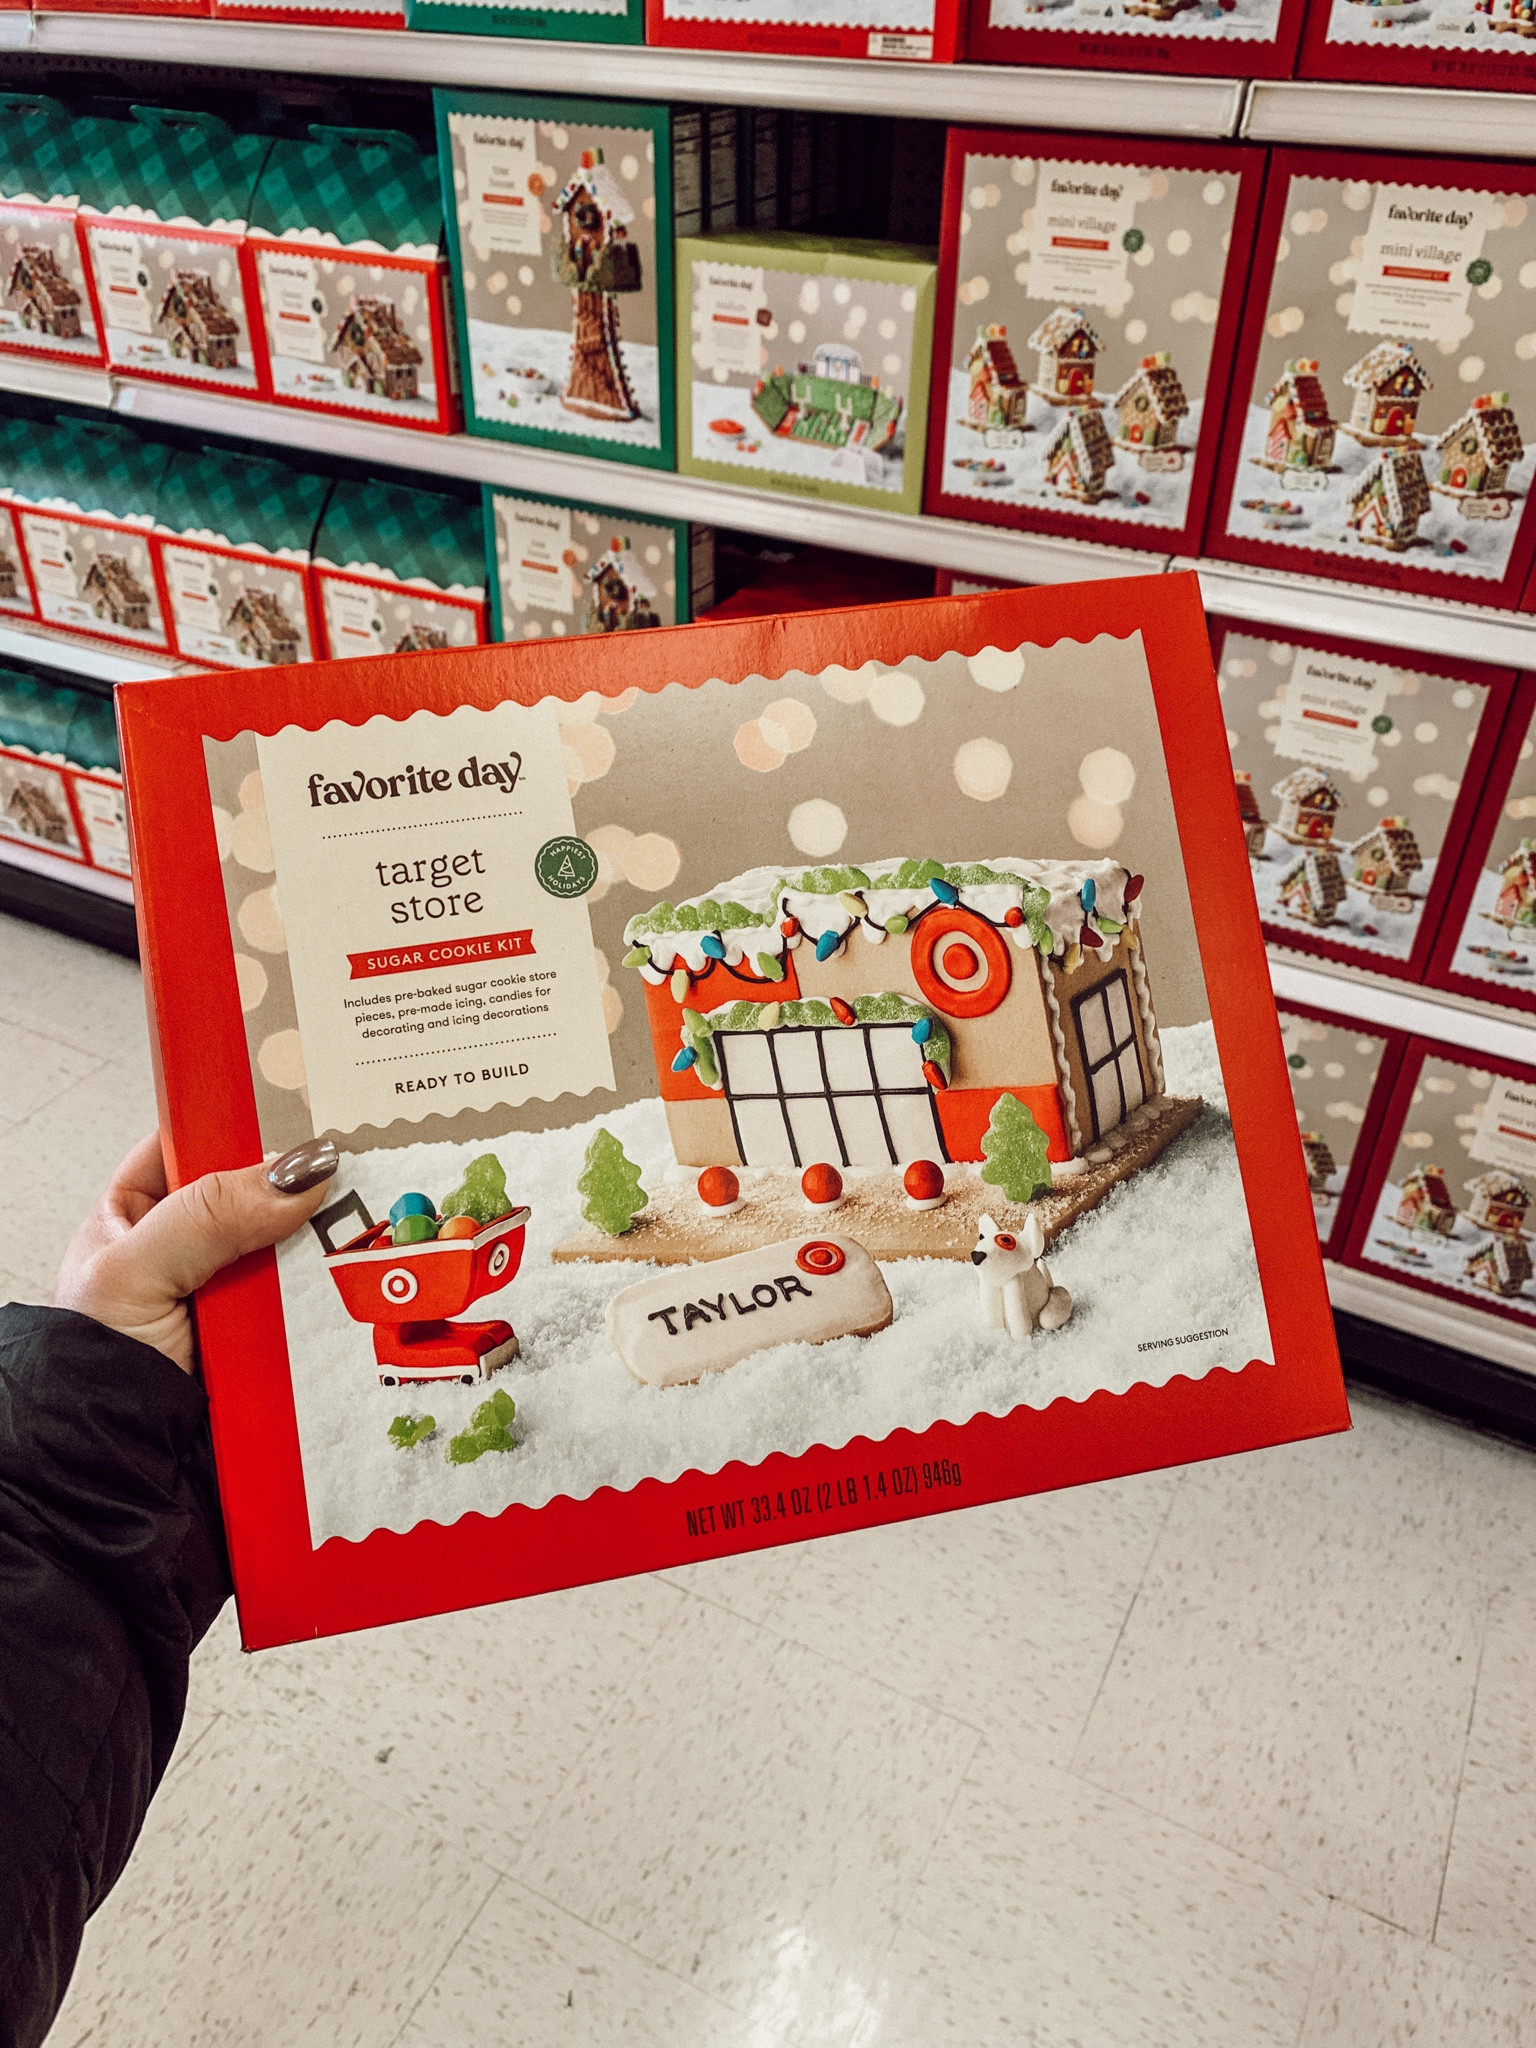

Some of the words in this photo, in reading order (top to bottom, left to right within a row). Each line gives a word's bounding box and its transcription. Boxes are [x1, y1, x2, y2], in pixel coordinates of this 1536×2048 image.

[1388, 204, 1443, 225] favorite
[1445, 211, 1473, 230] day
[1380, 242, 1413, 258] mini
[1415, 245, 1462, 265] village
[307, 764, 453, 808] favorite
[375, 849, 486, 888] target
[550, 845, 586, 860] HAPPIEST
[547, 874, 586, 890] HOLIDAYS
[390, 890, 485, 925] store
[367, 952, 424, 971] SUGAR
[429, 942, 493, 962] COOKIE
[497, 937, 523, 953] KIT
[343, 993, 392, 1009] Includes
[394, 984, 453, 1005] pre-baked
[455, 980, 488, 995] sugar
[490, 973, 527, 989] cookie
[529, 970, 558, 983] store
[355, 1009, 396, 1027] pieces,
[398, 1001, 453, 1020] pre-made
[455, 995, 487, 1010] icing,
[489, 989, 533, 1005] candies
[535, 986, 552, 998] for
[361, 1020, 425, 1040] decorating
[427, 1017, 450, 1030] and
[452, 1012, 481, 1027] icing
[483, 1003, 550, 1022] decorations
[395, 1075, 449, 1096] READY
[454, 1071, 477, 1087] TO
[482, 1063, 530, 1082] BUILD
[647, 1274, 813, 1336] TAYLOR
[1137, 1338, 1175, 1353] SERVING
[1175, 1328, 1229, 1346] SUGGESTION
[685, 1506, 717, 1537] NET
[719, 1499, 745, 1530] WT
[750, 1492, 787, 1525] 33.4
[791, 1486, 813, 1516] OZ
[816, 1482, 833, 1514] (2
[837, 1477, 860, 1507] LB
[862, 1471, 888, 1501] 1.4
[892, 1465, 919, 1496] OZ)
[922, 1458, 962, 1490] 946g
